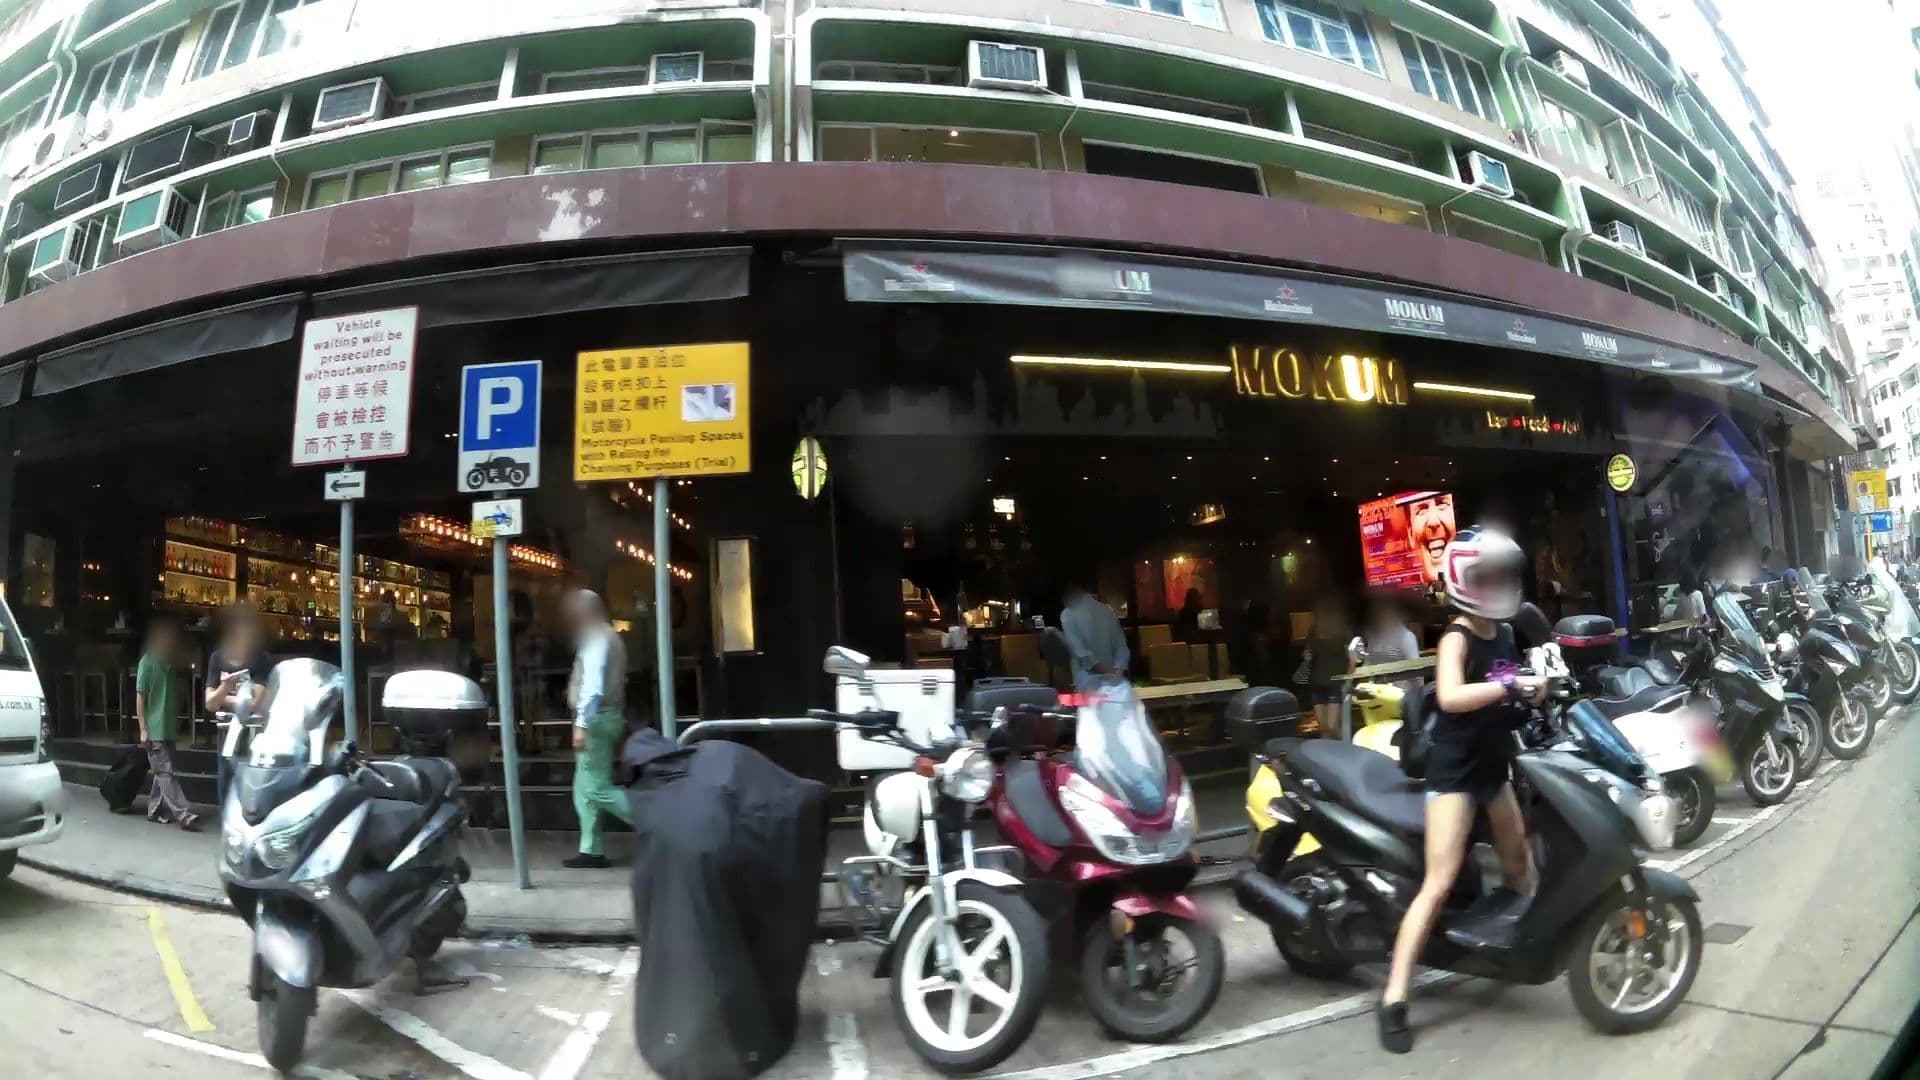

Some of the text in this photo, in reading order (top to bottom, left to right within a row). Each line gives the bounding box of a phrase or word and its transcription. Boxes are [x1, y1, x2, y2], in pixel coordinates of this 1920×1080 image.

[1384, 298, 1444, 322] MOKUM
[336, 319, 381, 333] Vehicle
[314, 331, 402, 350] waiting will be
[320, 346, 392, 365] prosecuted
[305, 360, 406, 380] without warning
[1231, 346, 1408, 405] MOKUM
[317, 379, 388, 403] 停車等候
[316, 406, 386, 429] 會被檢控
[477, 376, 523, 440] P
[304, 430, 395, 455] 而不予警告
[700, 431, 744, 443] Spaces
